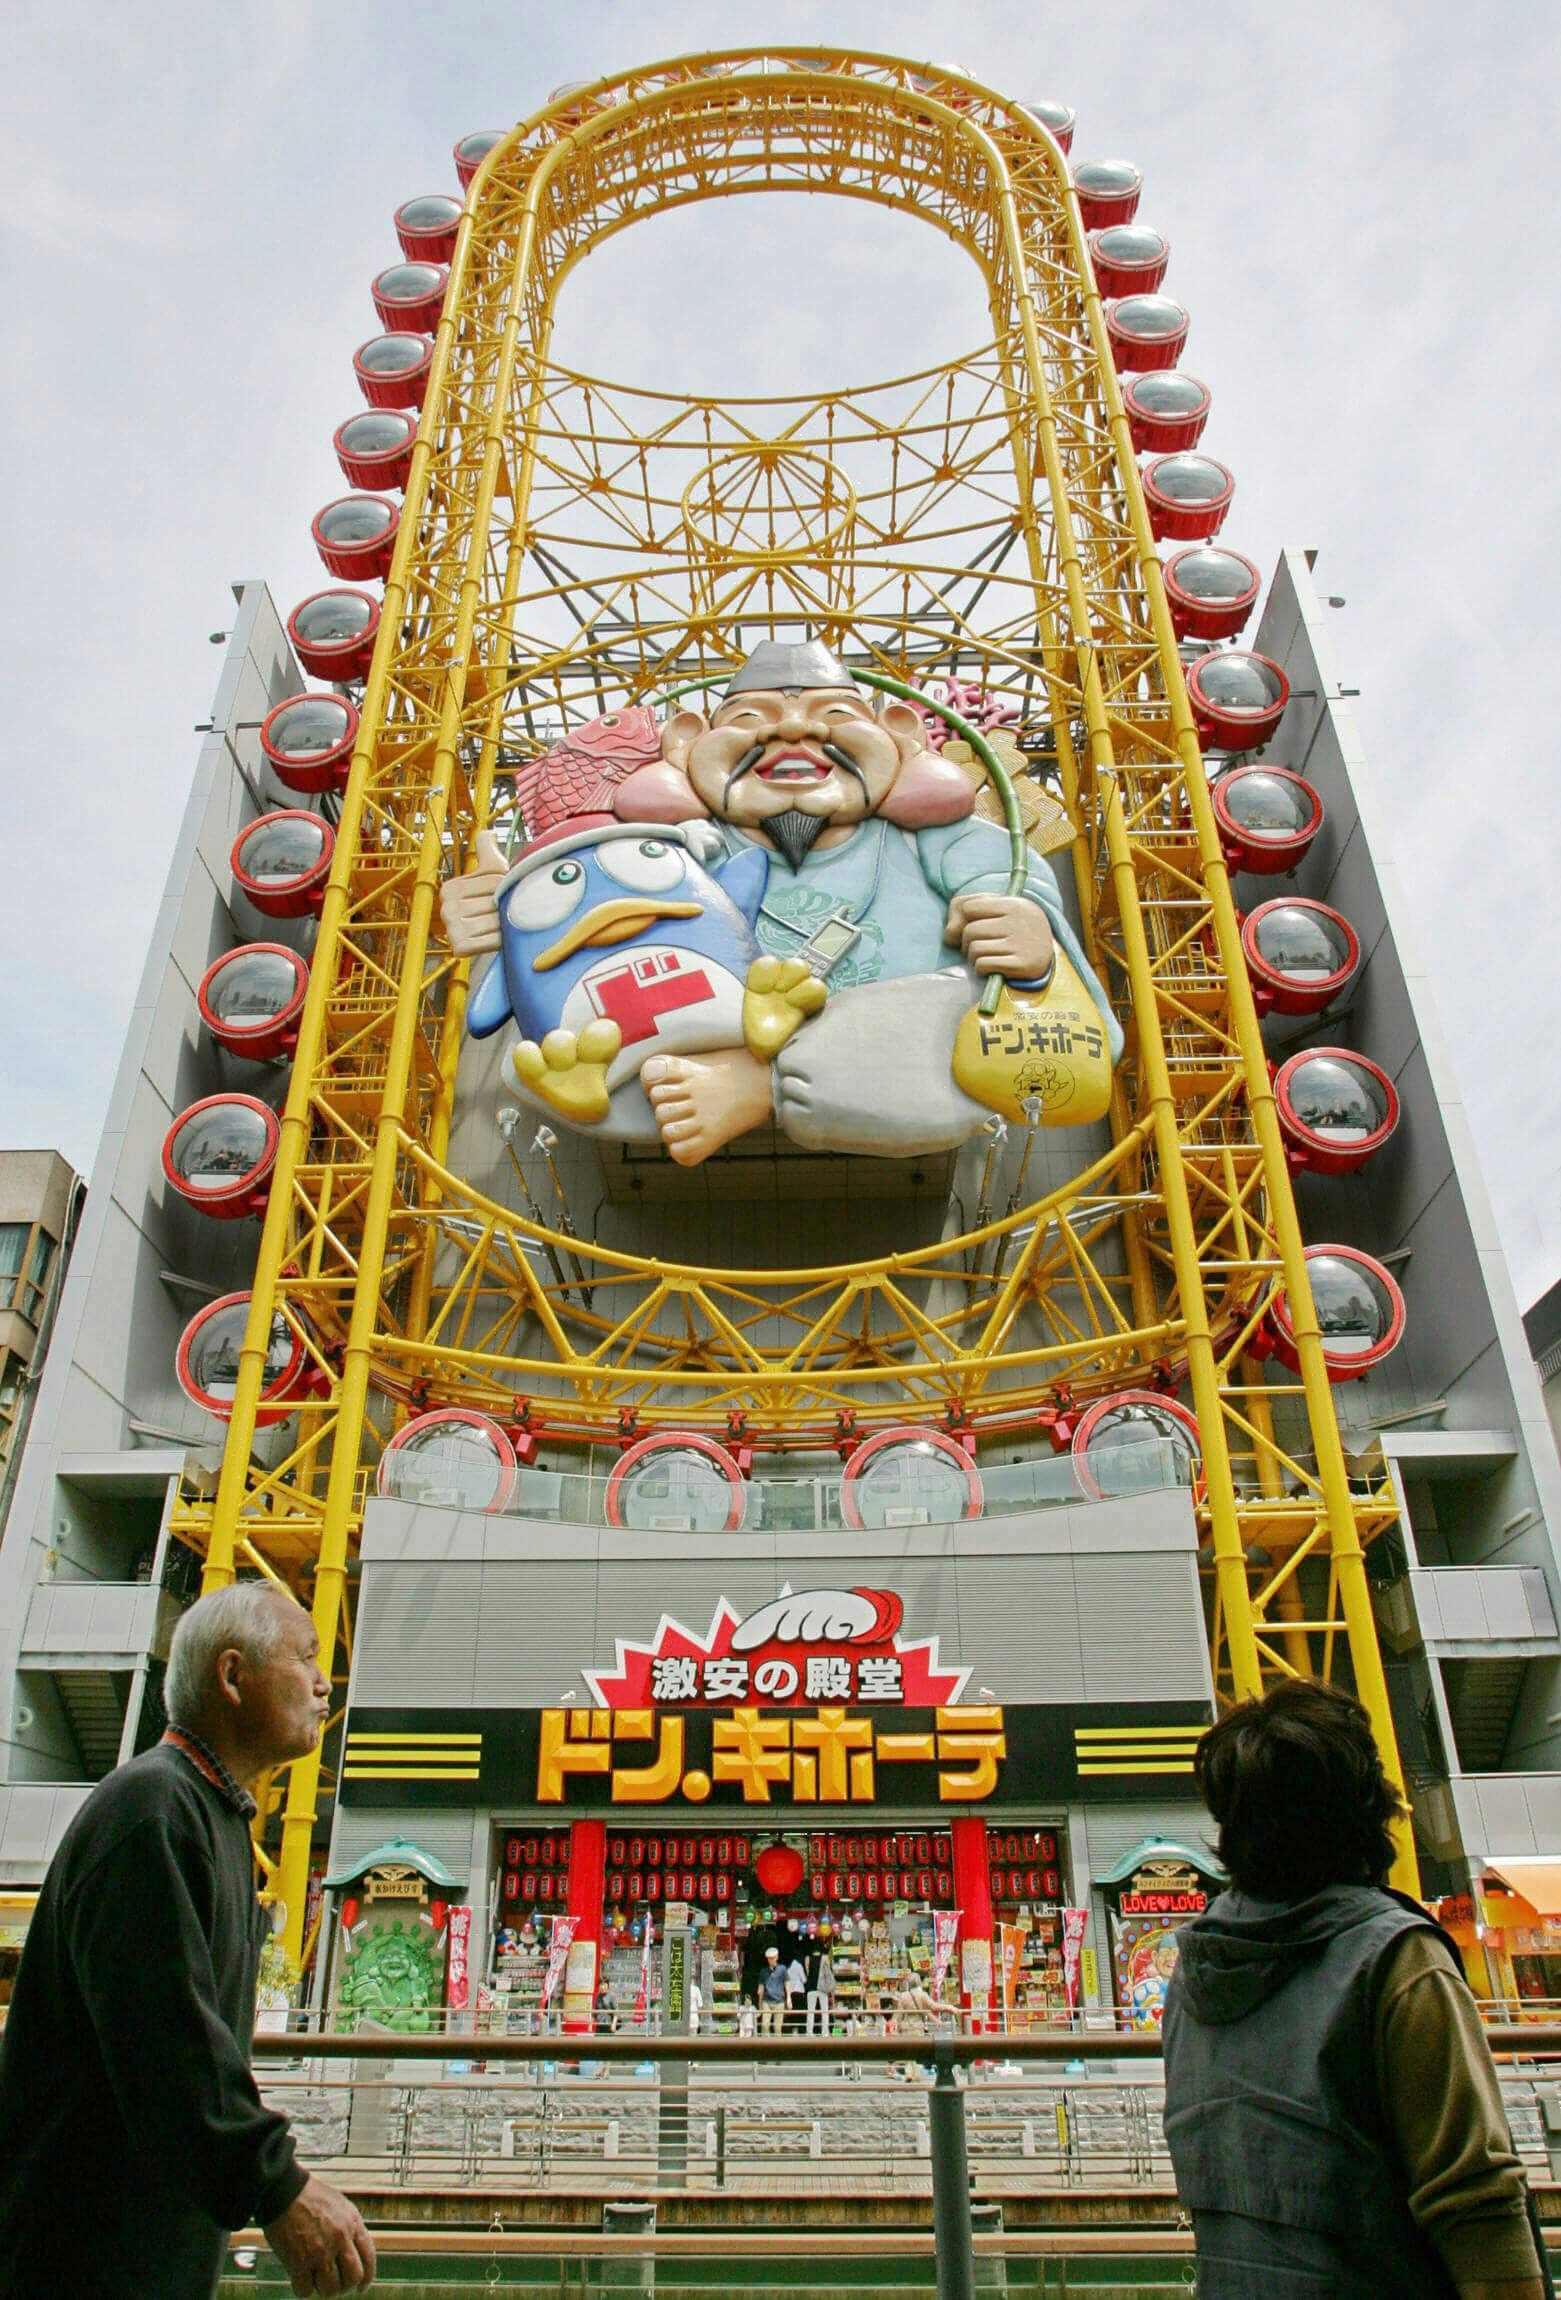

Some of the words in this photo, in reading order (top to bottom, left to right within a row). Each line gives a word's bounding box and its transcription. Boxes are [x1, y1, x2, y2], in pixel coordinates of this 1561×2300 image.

[138, 1562, 180, 1573] PLZA
[651, 1656, 904, 1702] 激安の殿堂
[1122, 1894, 1158, 1912] LOVE
[1170, 1893, 1206, 1912] LOVE
